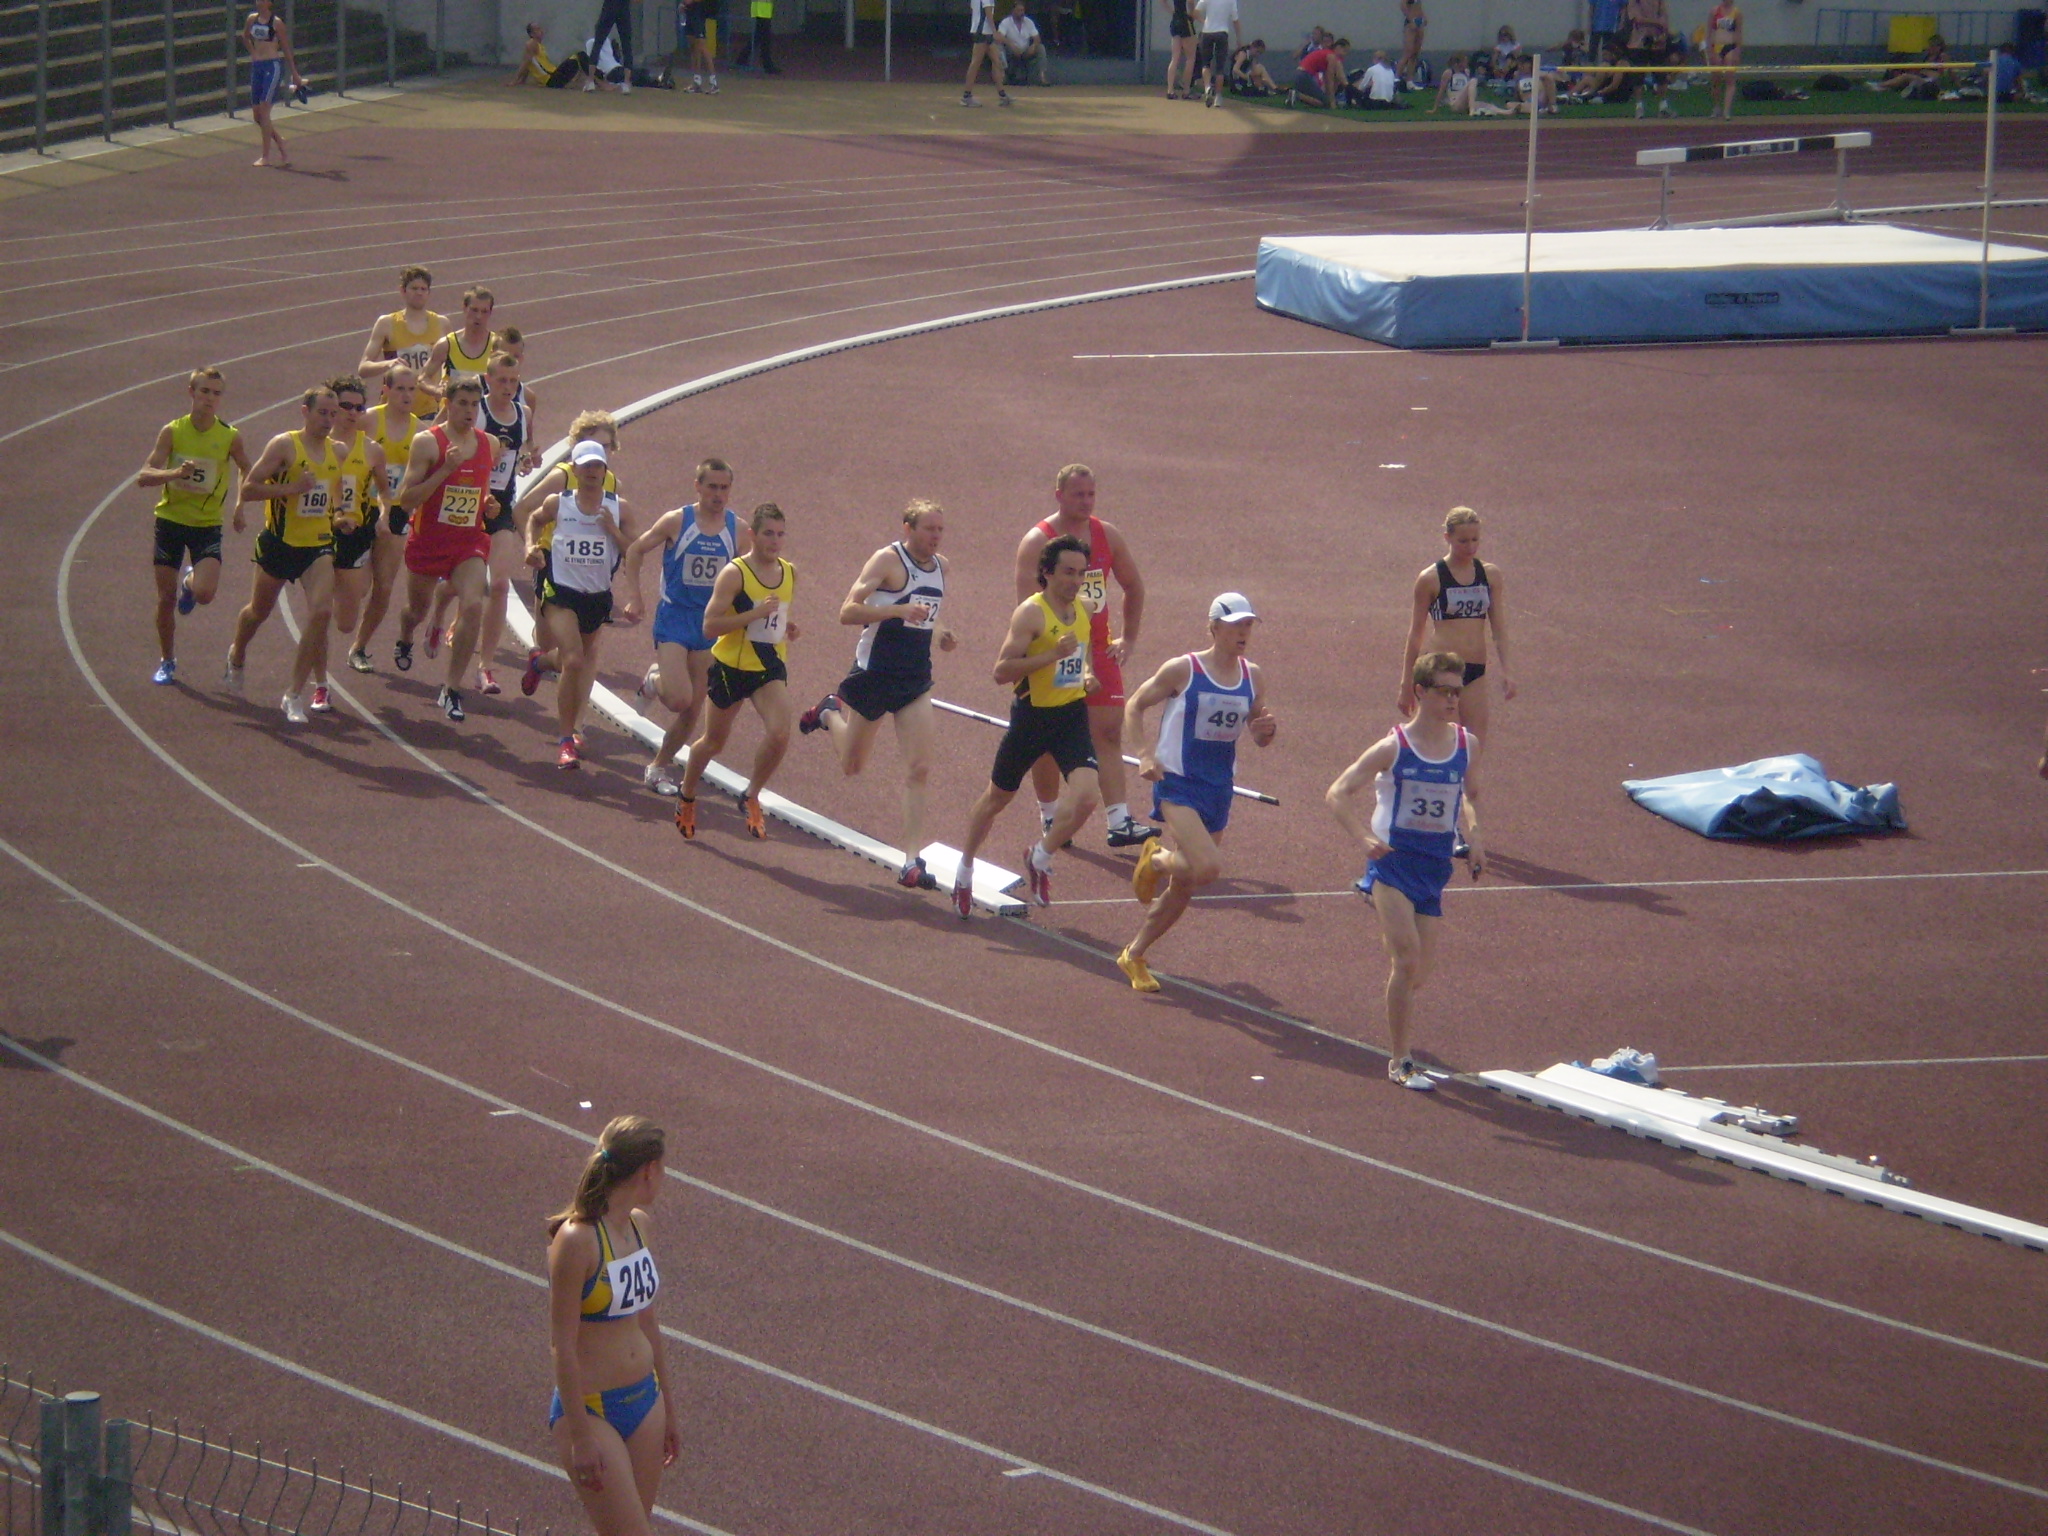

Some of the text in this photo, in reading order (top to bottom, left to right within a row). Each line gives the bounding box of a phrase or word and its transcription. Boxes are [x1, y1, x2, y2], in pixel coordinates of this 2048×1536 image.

[303, 493, 328, 507] 160
[444, 496, 477, 513] 222
[566, 540, 605, 556] 185
[691, 556, 718, 579] 65
[1457, 600, 1483, 616] 284
[1059, 659, 1083, 675] 159
[1208, 710, 1239, 728] 49
[1411, 798, 1445, 818] 33
[620, 1256, 656, 1310] 243
